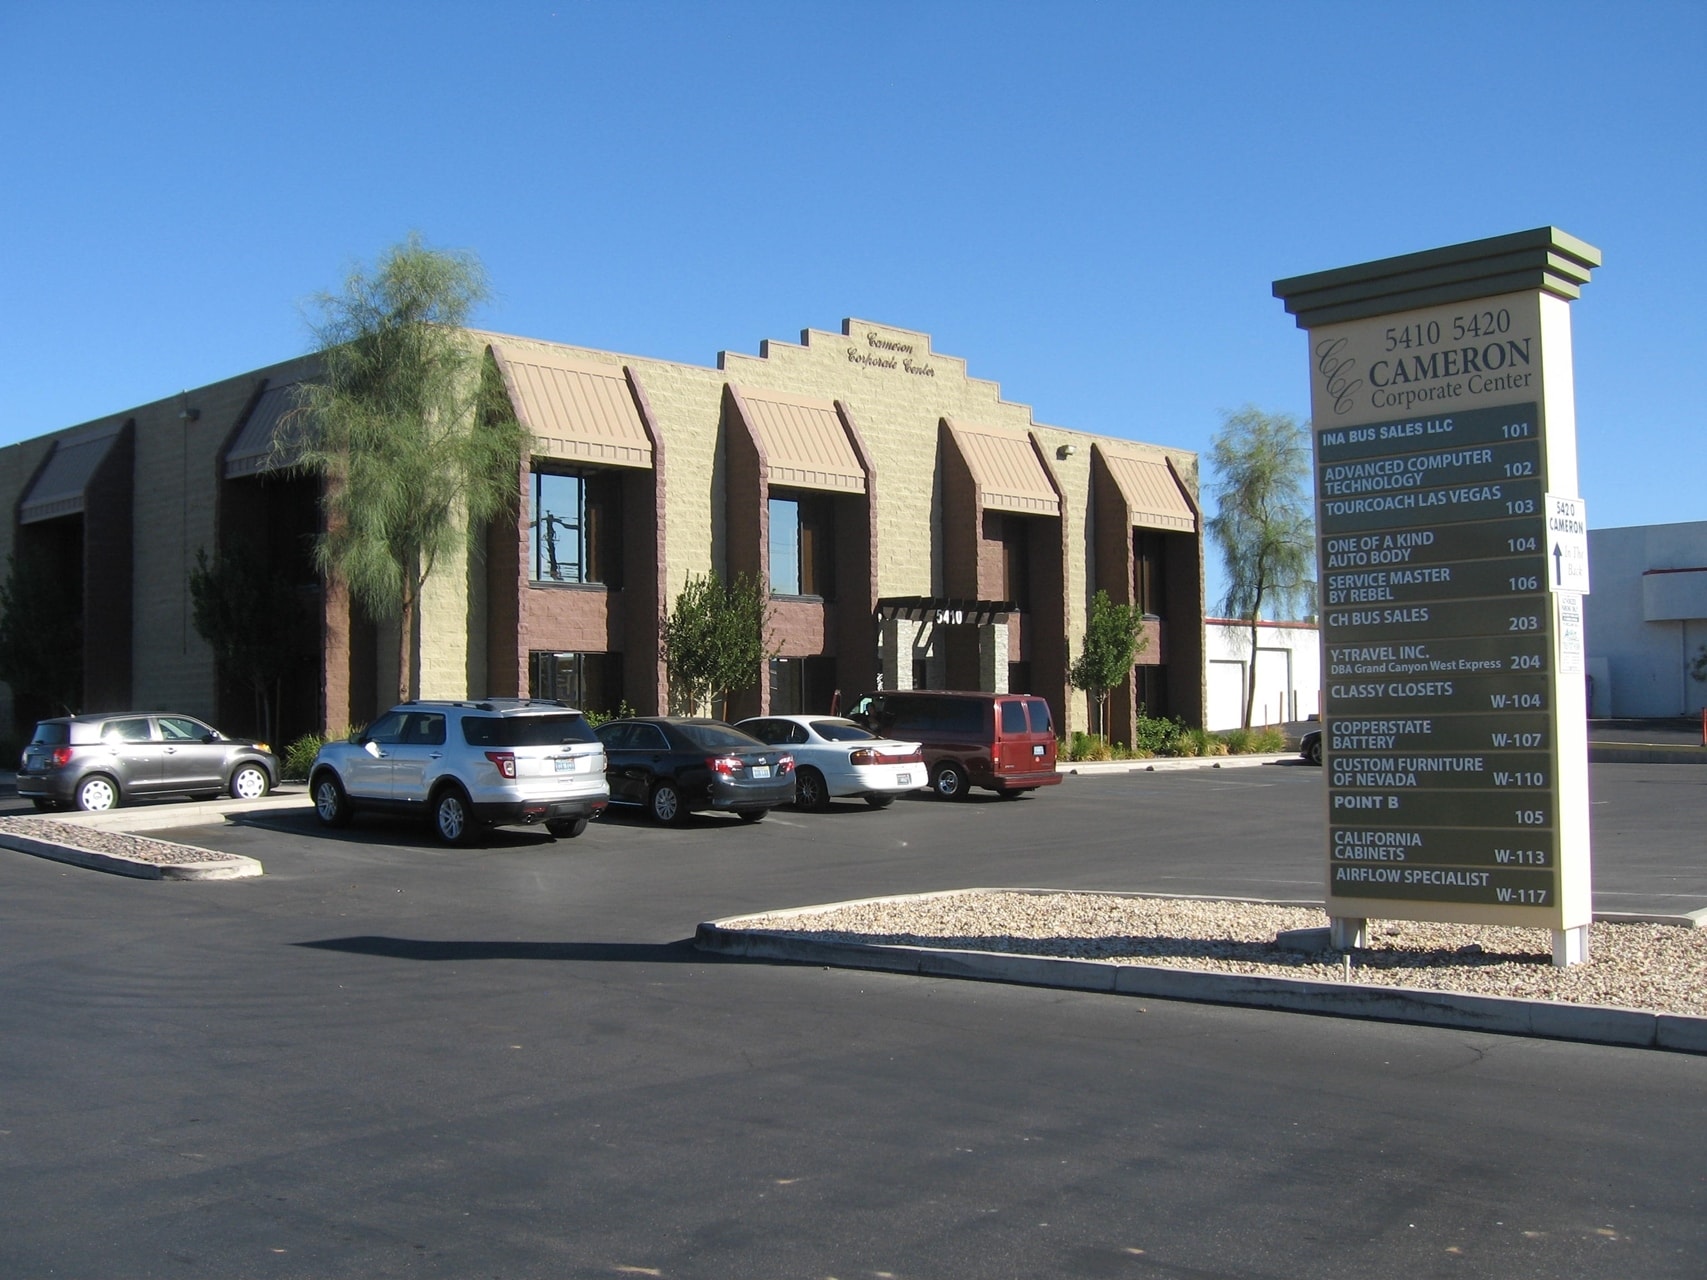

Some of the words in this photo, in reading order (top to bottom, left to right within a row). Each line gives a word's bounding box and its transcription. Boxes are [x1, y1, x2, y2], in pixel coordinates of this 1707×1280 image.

[1386, 321, 1440, 352] 5410
[1453, 309, 1510, 340] 5420
[867, 332, 913, 355] Cameron
[847, 347, 897, 370] Corporate
[903, 358, 935, 377] Center
[1369, 338, 1532, 387] CAMERON
[1371, 381, 1462, 410] Corporate
[1468, 370, 1532, 395] Center
[1322, 430, 1345, 446] INA
[1349, 428, 1376, 443] BUS
[1380, 423, 1423, 441] SALES
[1427, 419, 1453, 434] LLC
[1502, 423, 1529, 438] 101
[1324, 458, 1404, 481] ADVANCED
[1408, 450, 1492, 471] COMPUTER
[1504, 461, 1532, 477] 102
[1324, 472, 1423, 495] TECHNOLOGY
[1326, 492, 1415, 515] TOURCOACH
[1419, 492, 1446, 507] LAS
[1450, 486, 1501, 502] VEGAS
[1506, 500, 1534, 514] 103
[1556, 501, 1575, 517] 5420
[1550, 517, 1584, 534] CAMERON
[1327, 538, 1357, 554] ONE
[1361, 536, 1379, 551] OF
[1383, 535, 1394, 549] A
[1397, 532, 1434, 547] KIND
[1508, 537, 1536, 552] 104
[1328, 552, 1368, 568] AUTO
[1371, 548, 1411, 564] BODY
[1329, 572, 1387, 589] SERVICE
[1390, 568, 1450, 585] MASTER
[1509, 577, 1537, 591] 106
[1329, 590, 1348, 604] BY
[1350, 588, 1394, 602] REBEL
[936, 609, 963, 625] 5410
[1329, 613, 1349, 627] CH
[1352, 611, 1380, 625] BUS
[1384, 608, 1429, 623] SALES
[1509, 616, 1537, 631] 203
[1331, 647, 1396, 662] Y-TRAVEL
[1400, 645, 1430, 659] INC.
[1331, 663, 1352, 674] DBA
[1354, 661, 1386, 673] Grand
[1389, 661, 1428, 674] Canyon
[1430, 660, 1457, 671] West
[1459, 659, 1501, 672] Express
[1511, 655, 1540, 669] 204
[1331, 683, 1385, 698] CLASSY
[1389, 681, 1453, 697] CLOSETS
[1491, 694, 1541, 708] W-104
[1332, 720, 1432, 735] COPPERSTATE
[1333, 736, 1395, 749] BATTERY
[1492, 733, 1541, 747] W-107
[1333, 758, 1395, 772] CUSTOM
[1398, 757, 1483, 772] FURNITURE
[1333, 773, 1353, 786] OF
[1356, 773, 1417, 786] NEVADA
[1493, 772, 1543, 786] W-110
[1334, 796, 1383, 809] POINT
[1388, 796, 1399, 809] B
[1515, 810, 1543, 824] 105
[1334, 831, 1422, 846] CALIFORNIA
[1334, 846, 1405, 861] CABINETS
[1494, 849, 1545, 864] W-113
[1336, 867, 1400, 883] AIRFLOW
[1404, 870, 1489, 887] SPECIALIST
[1496, 888, 1547, 903] W-117
